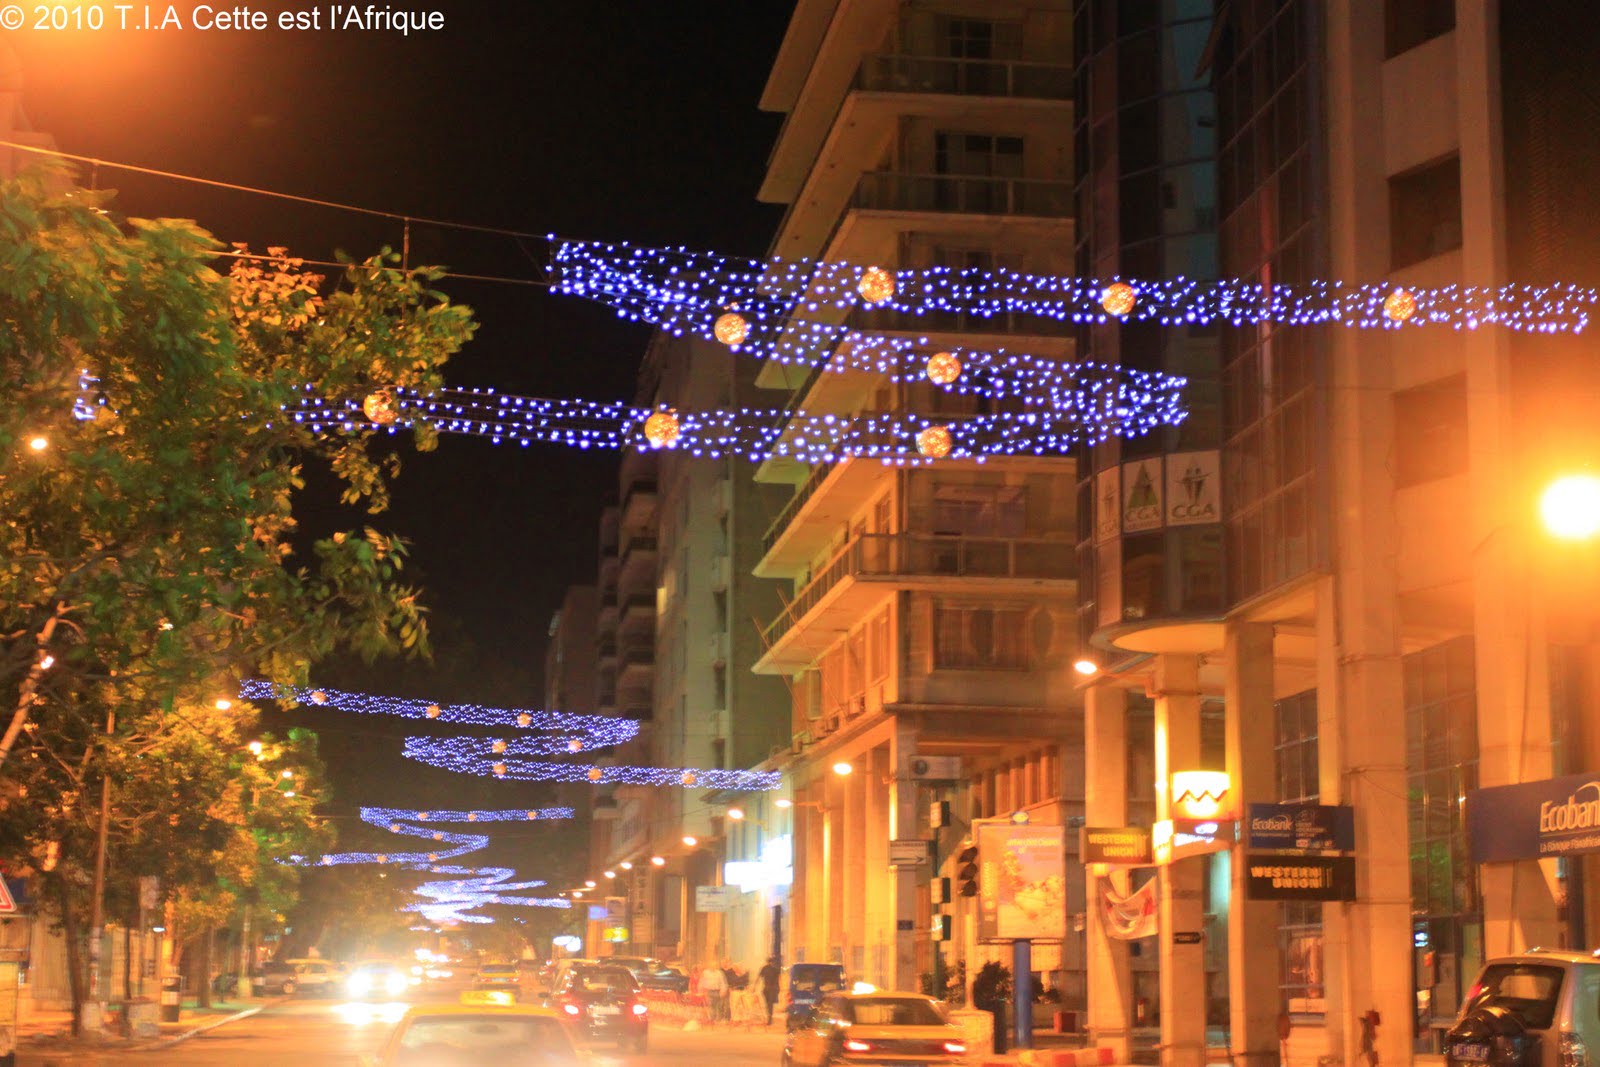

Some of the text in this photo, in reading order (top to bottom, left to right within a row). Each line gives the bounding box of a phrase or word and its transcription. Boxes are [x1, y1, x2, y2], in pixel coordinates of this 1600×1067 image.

[1171, 503, 1216, 518] CGA
[1540, 782, 1600, 832] Ecoban
[1251, 815, 1294, 831] Ecobank
[1088, 833, 1135, 845] WESTERN
[1102, 846, 1135, 857] UNION
[1250, 866, 1321, 878] WESTERN
[1272, 878, 1322, 889] UNION
